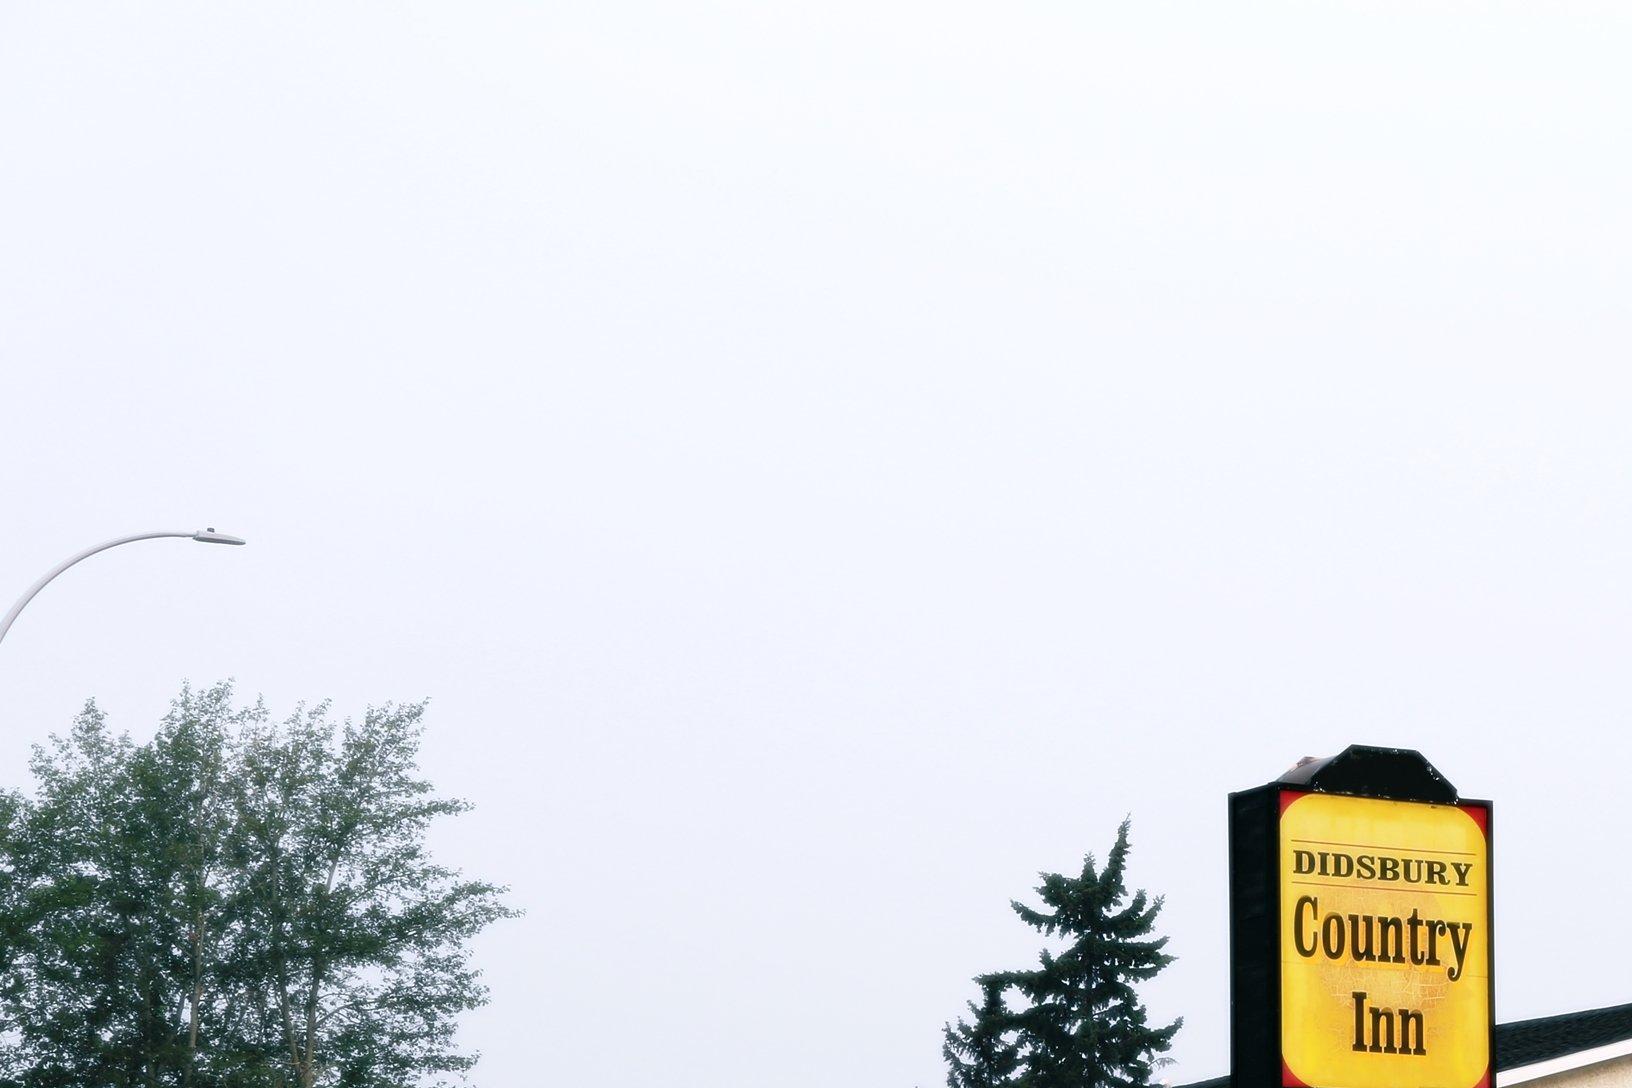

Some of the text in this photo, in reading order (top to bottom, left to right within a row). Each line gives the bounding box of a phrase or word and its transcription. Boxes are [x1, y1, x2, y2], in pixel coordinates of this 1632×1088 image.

[1293, 849, 1473, 887] DIDSBURY
[1293, 895, 1473, 982] Country
[1352, 991, 1427, 1056] Inn
